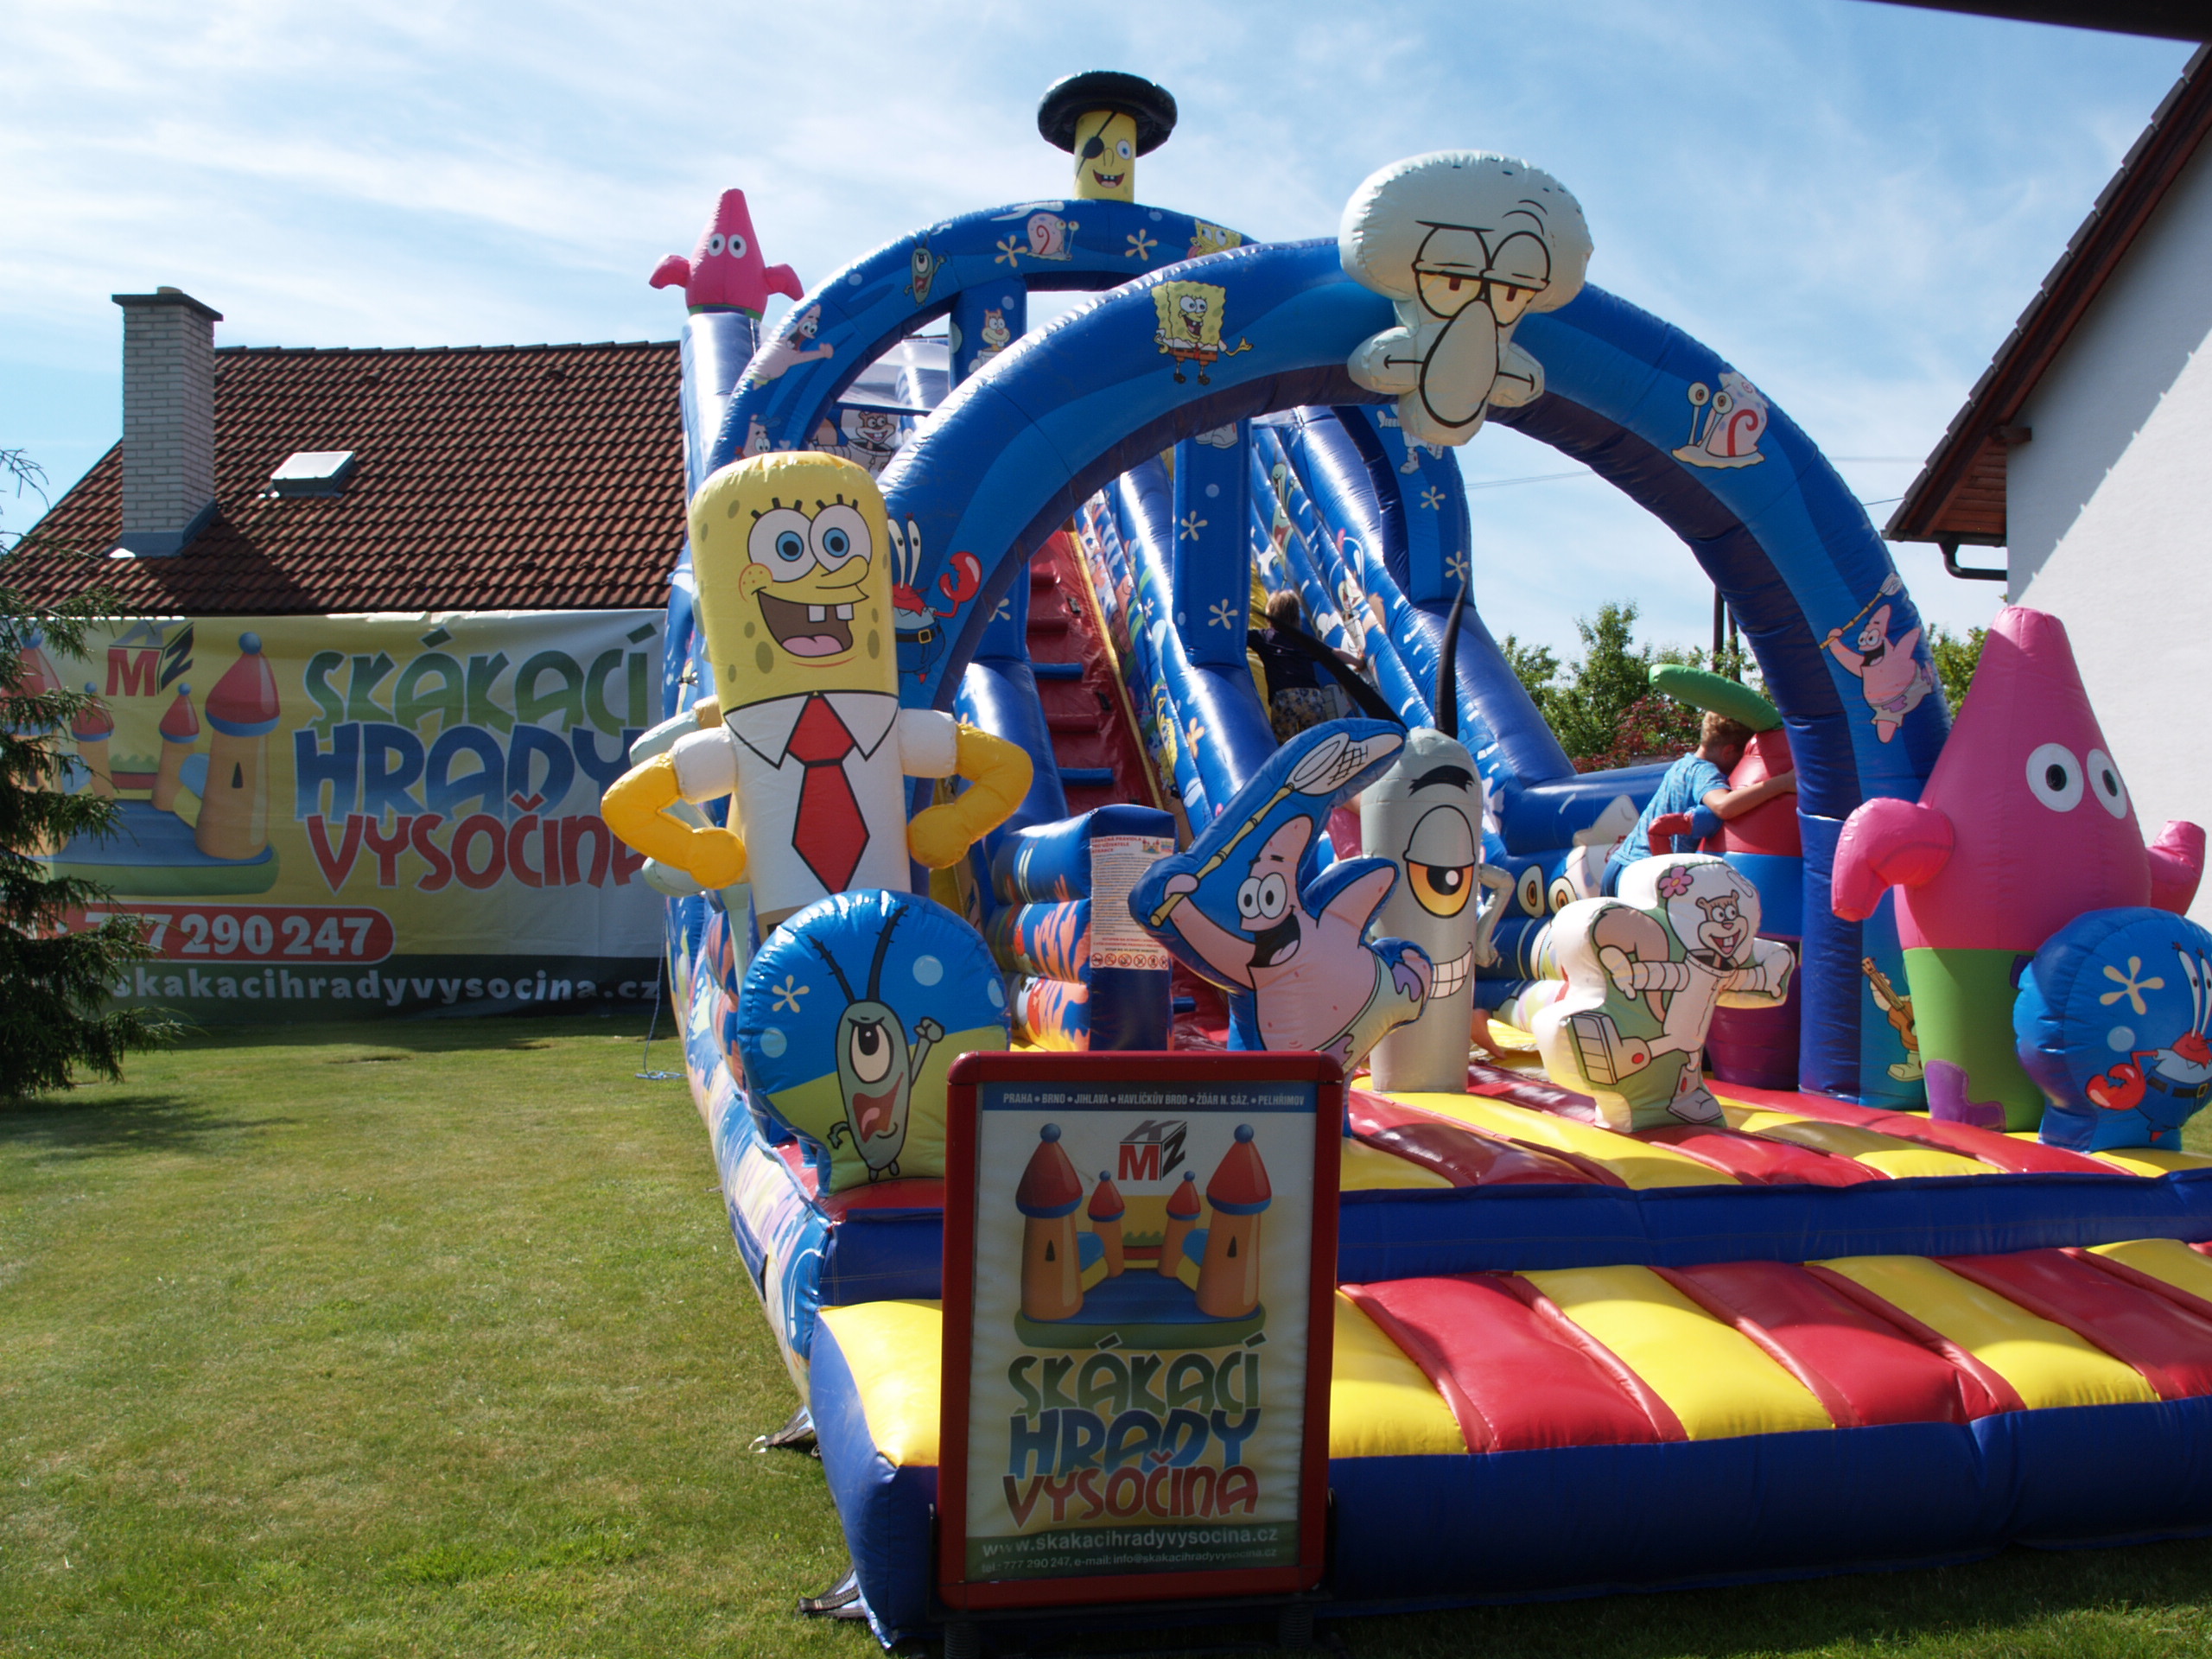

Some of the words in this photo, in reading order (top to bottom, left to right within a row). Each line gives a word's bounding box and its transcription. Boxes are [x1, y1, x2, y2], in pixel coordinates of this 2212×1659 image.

[304, 623, 657, 739] SKÁKACÍ
[181, 914, 272, 954] 290
[283, 916, 372, 955] 247
[1003, 1093, 1033, 1103] PRAHA
[1041, 1093, 1065, 1103] BRNO
[1074, 1093, 1109, 1104] JIHLAVA
[1117, 1091, 1164, 1105] HAVLÍČKŮV
[1165, 1094, 1187, 1105] BROD
[1220, 1094, 1229, 1105] N.
[1230, 1092, 1249, 1105] SÁZ.
[1258, 1092, 1305, 1106] PELHŘIMOV
[1007, 1332, 1267, 1420] SKÁKACÍ
[1009, 1408, 1261, 1479] HRADY
[1003, 1450, 1259, 1529] VYSOČINA
[982, 1525, 1278, 1556] www.skakacihradyvysocina.cz
[1003, 1560, 1023, 1570] 777
[1027, 1558, 1048, 1568] 290
[1074, 1554, 1112, 1567] e-mail:
[1113, 1548, 1277, 1565] info@skakacihradyvysocina.cz
